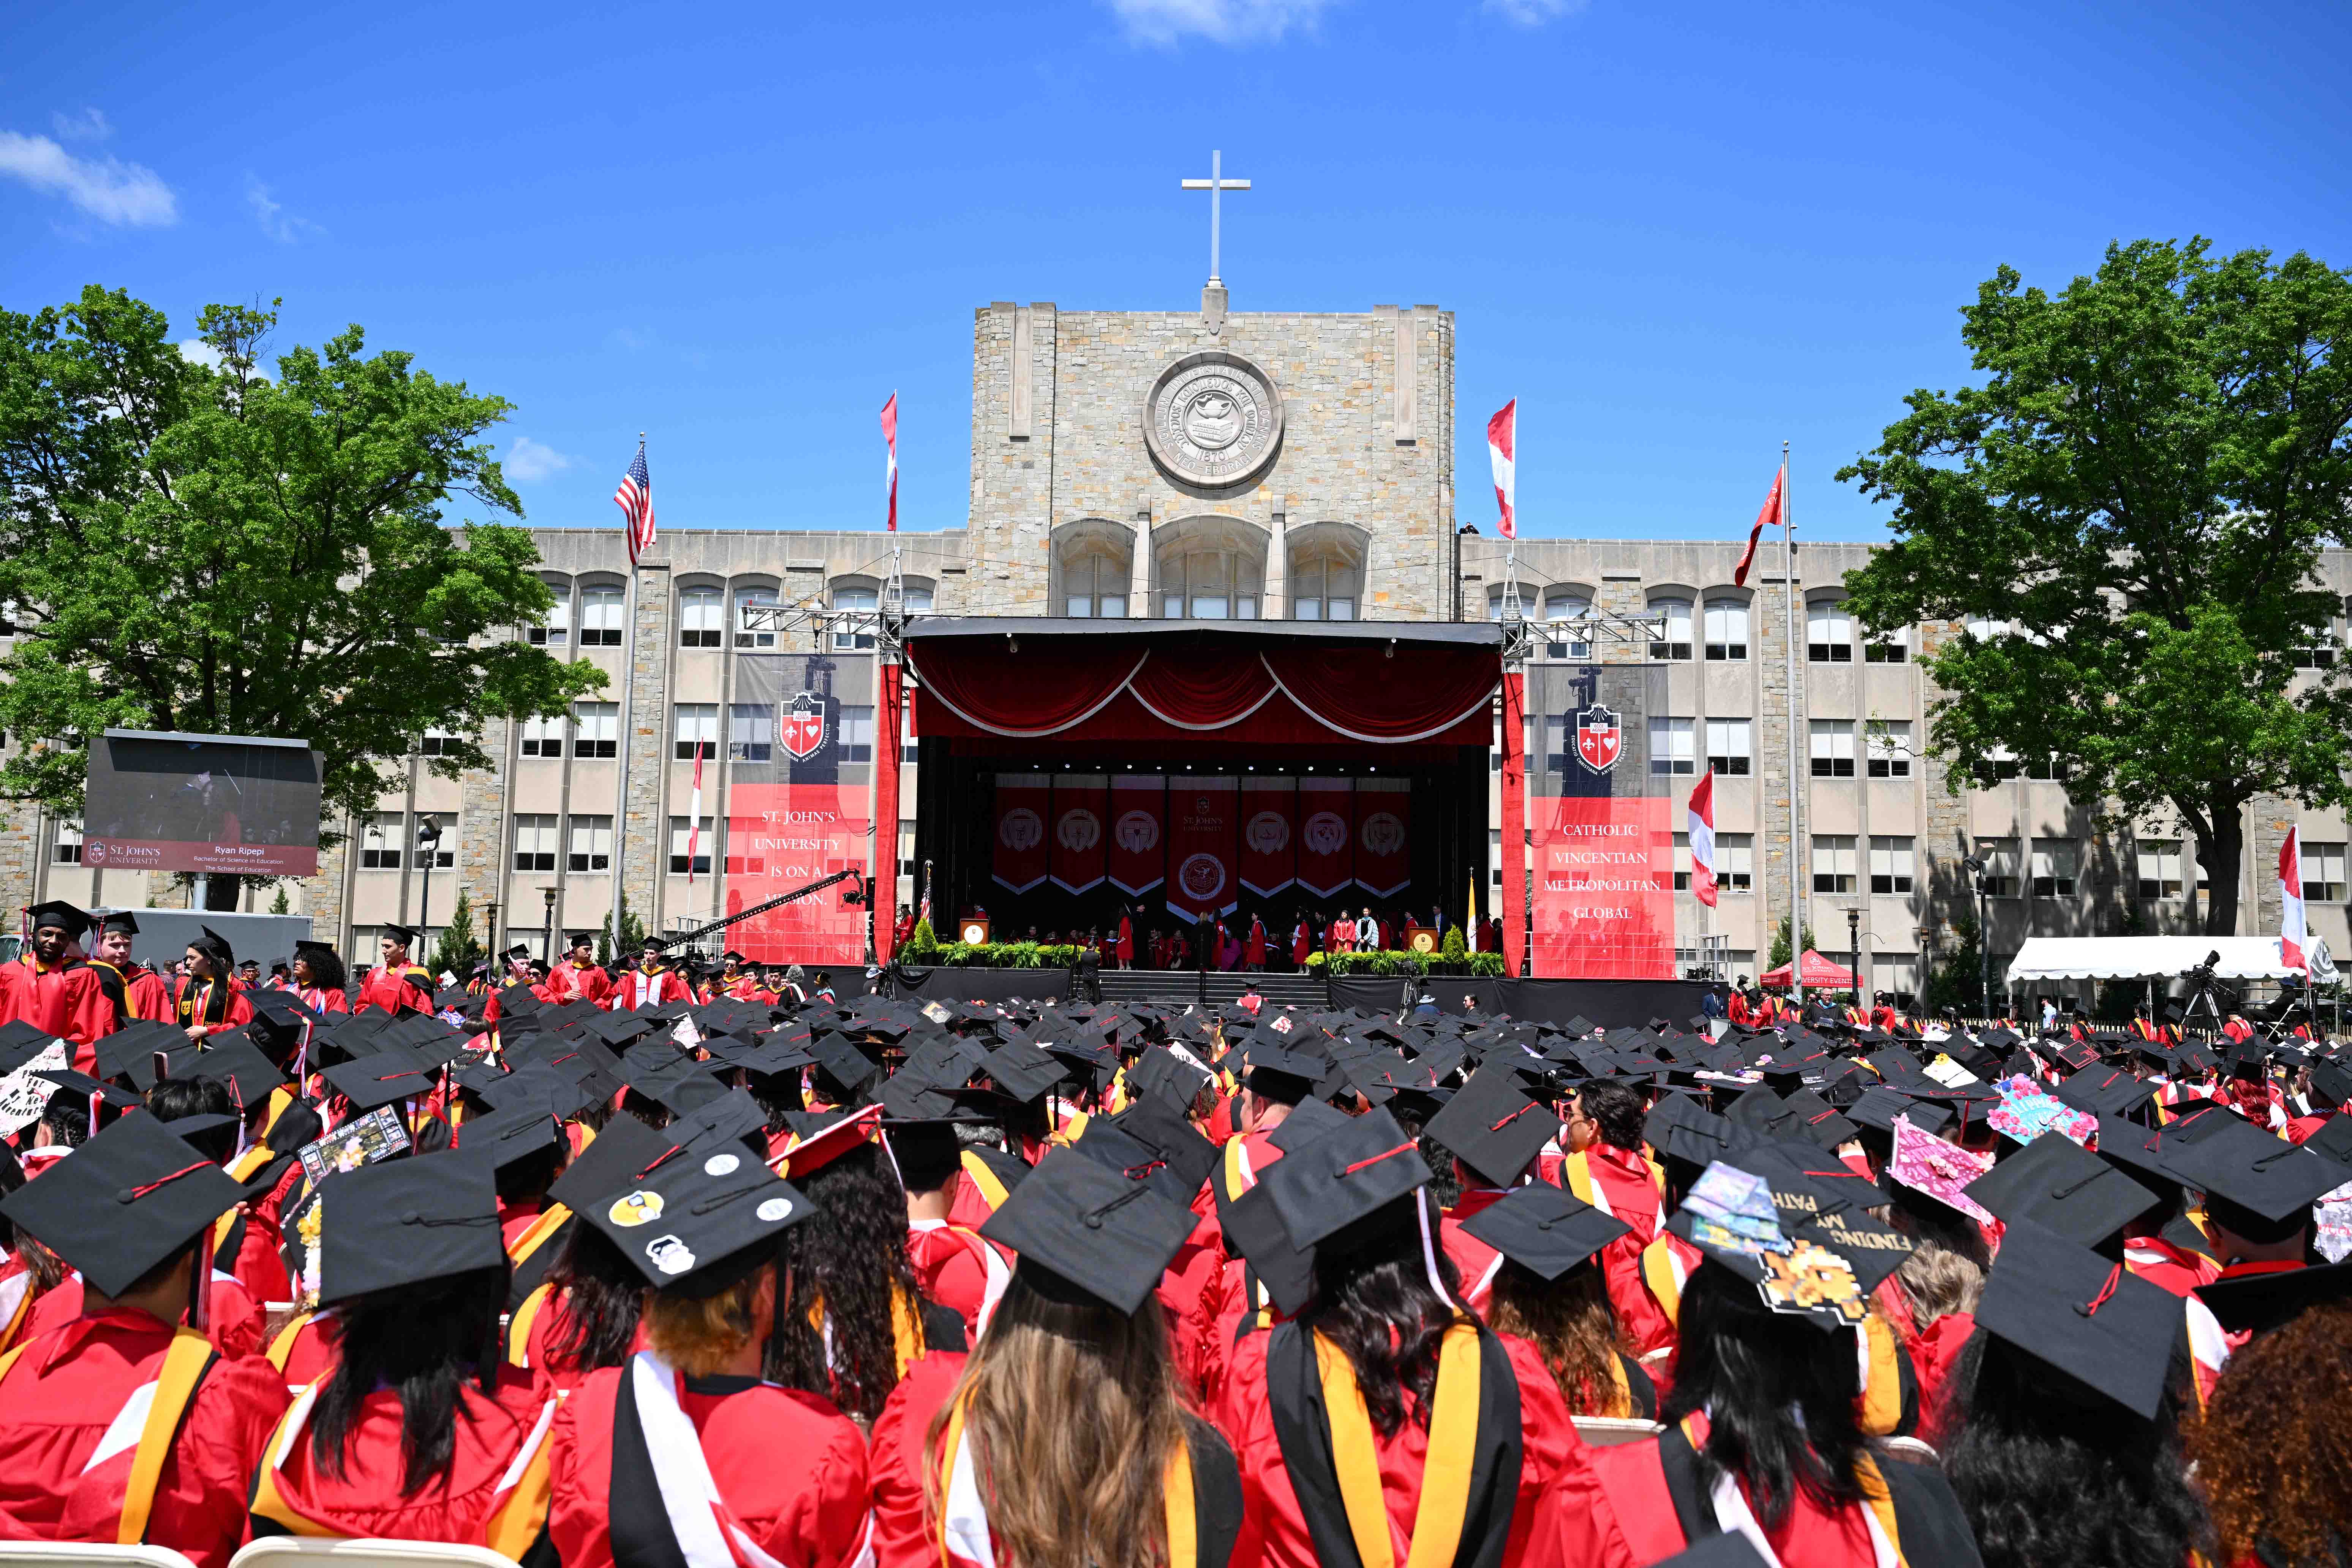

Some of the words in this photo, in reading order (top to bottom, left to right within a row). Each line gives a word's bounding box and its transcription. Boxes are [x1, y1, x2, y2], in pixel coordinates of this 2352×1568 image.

[1168, 365, 1245, 390] UNIVERSITATIS
[1252, 403, 1271, 450] JOANNIS
[1199, 450, 1226, 462] 1870
[778, 745, 799, 762] CHRISTIANA
[802, 749, 820, 763] ANIMAE
[820, 723, 830, 750] PERFECTIO
[1577, 758, 1598, 775] CHRISTIANA
[1601, 762, 1619, 776] ANIMAE
[1618, 735, 1628, 762] PERFECTIO
[762, 811, 781, 822] ST.
[783, 811, 835, 825] JOHN'S
[1563, 825, 1638, 836] CATHOLIC
[755, 838, 842, 850] UNIVERSITY
[110, 845, 123, 855] ST.
[125, 846, 160, 857] JOHN'S
[215, 846, 236, 855] Ryan
[239, 847, 264, 856] Ripepi
[1555, 852, 1648, 863] VINCENTIAN
[771, 866, 782, 877] IS
[786, 866, 809, 877] ON
[813, 866, 821, 877] A
[1544, 880, 1661, 891] METROPOLITAN
[1574, 907, 1633, 918] GLOBAL
[26, 1078, 45, 1087] For
[1770, 1191, 1818, 1212] PATH
[1816, 1213, 1845, 1230] MY
[1833, 1230, 1913, 1252] FINDING
